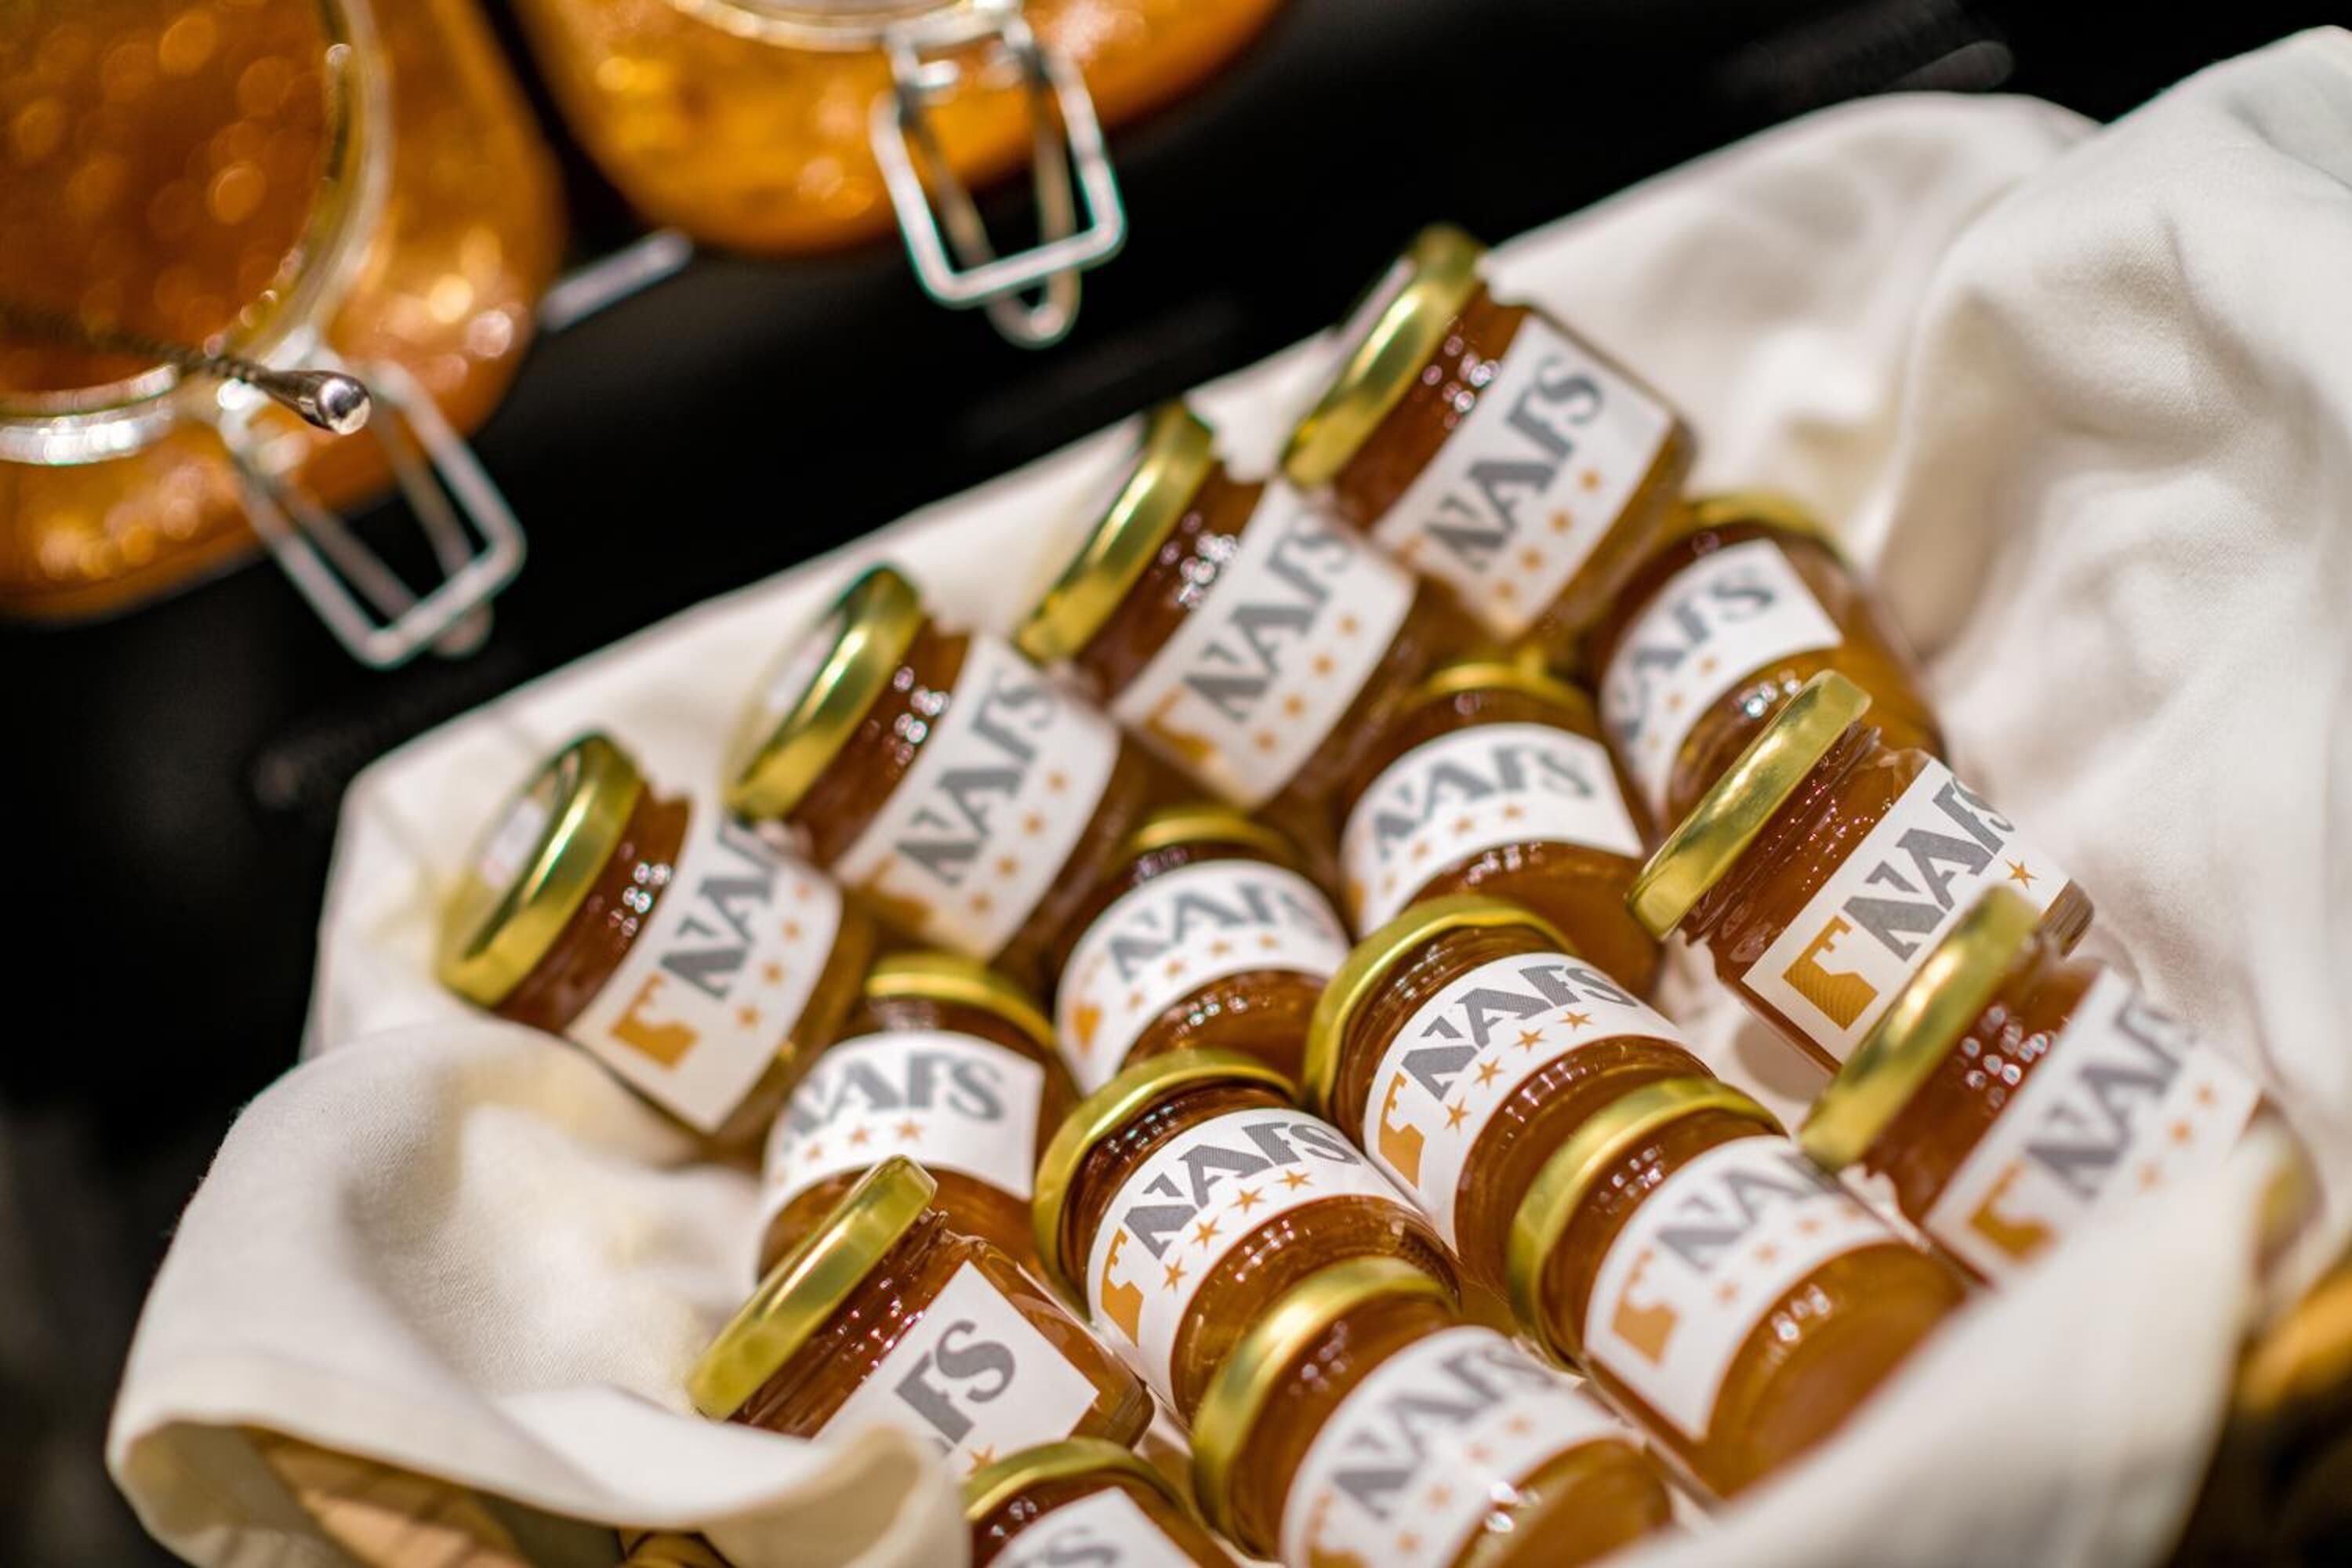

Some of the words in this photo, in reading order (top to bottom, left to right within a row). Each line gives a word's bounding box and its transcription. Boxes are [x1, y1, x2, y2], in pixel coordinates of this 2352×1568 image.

[1423, 353, 1604, 572] NAFS
[1374, 743, 1595, 861] NAFS
[660, 822, 788, 1000] NAF
[1401, 964, 1639, 1102] NAFS
[1124, 1122, 1361, 1261] NAFS
[1656, 1152, 1844, 1272] NAF
[894, 1319, 1017, 1457] FS
